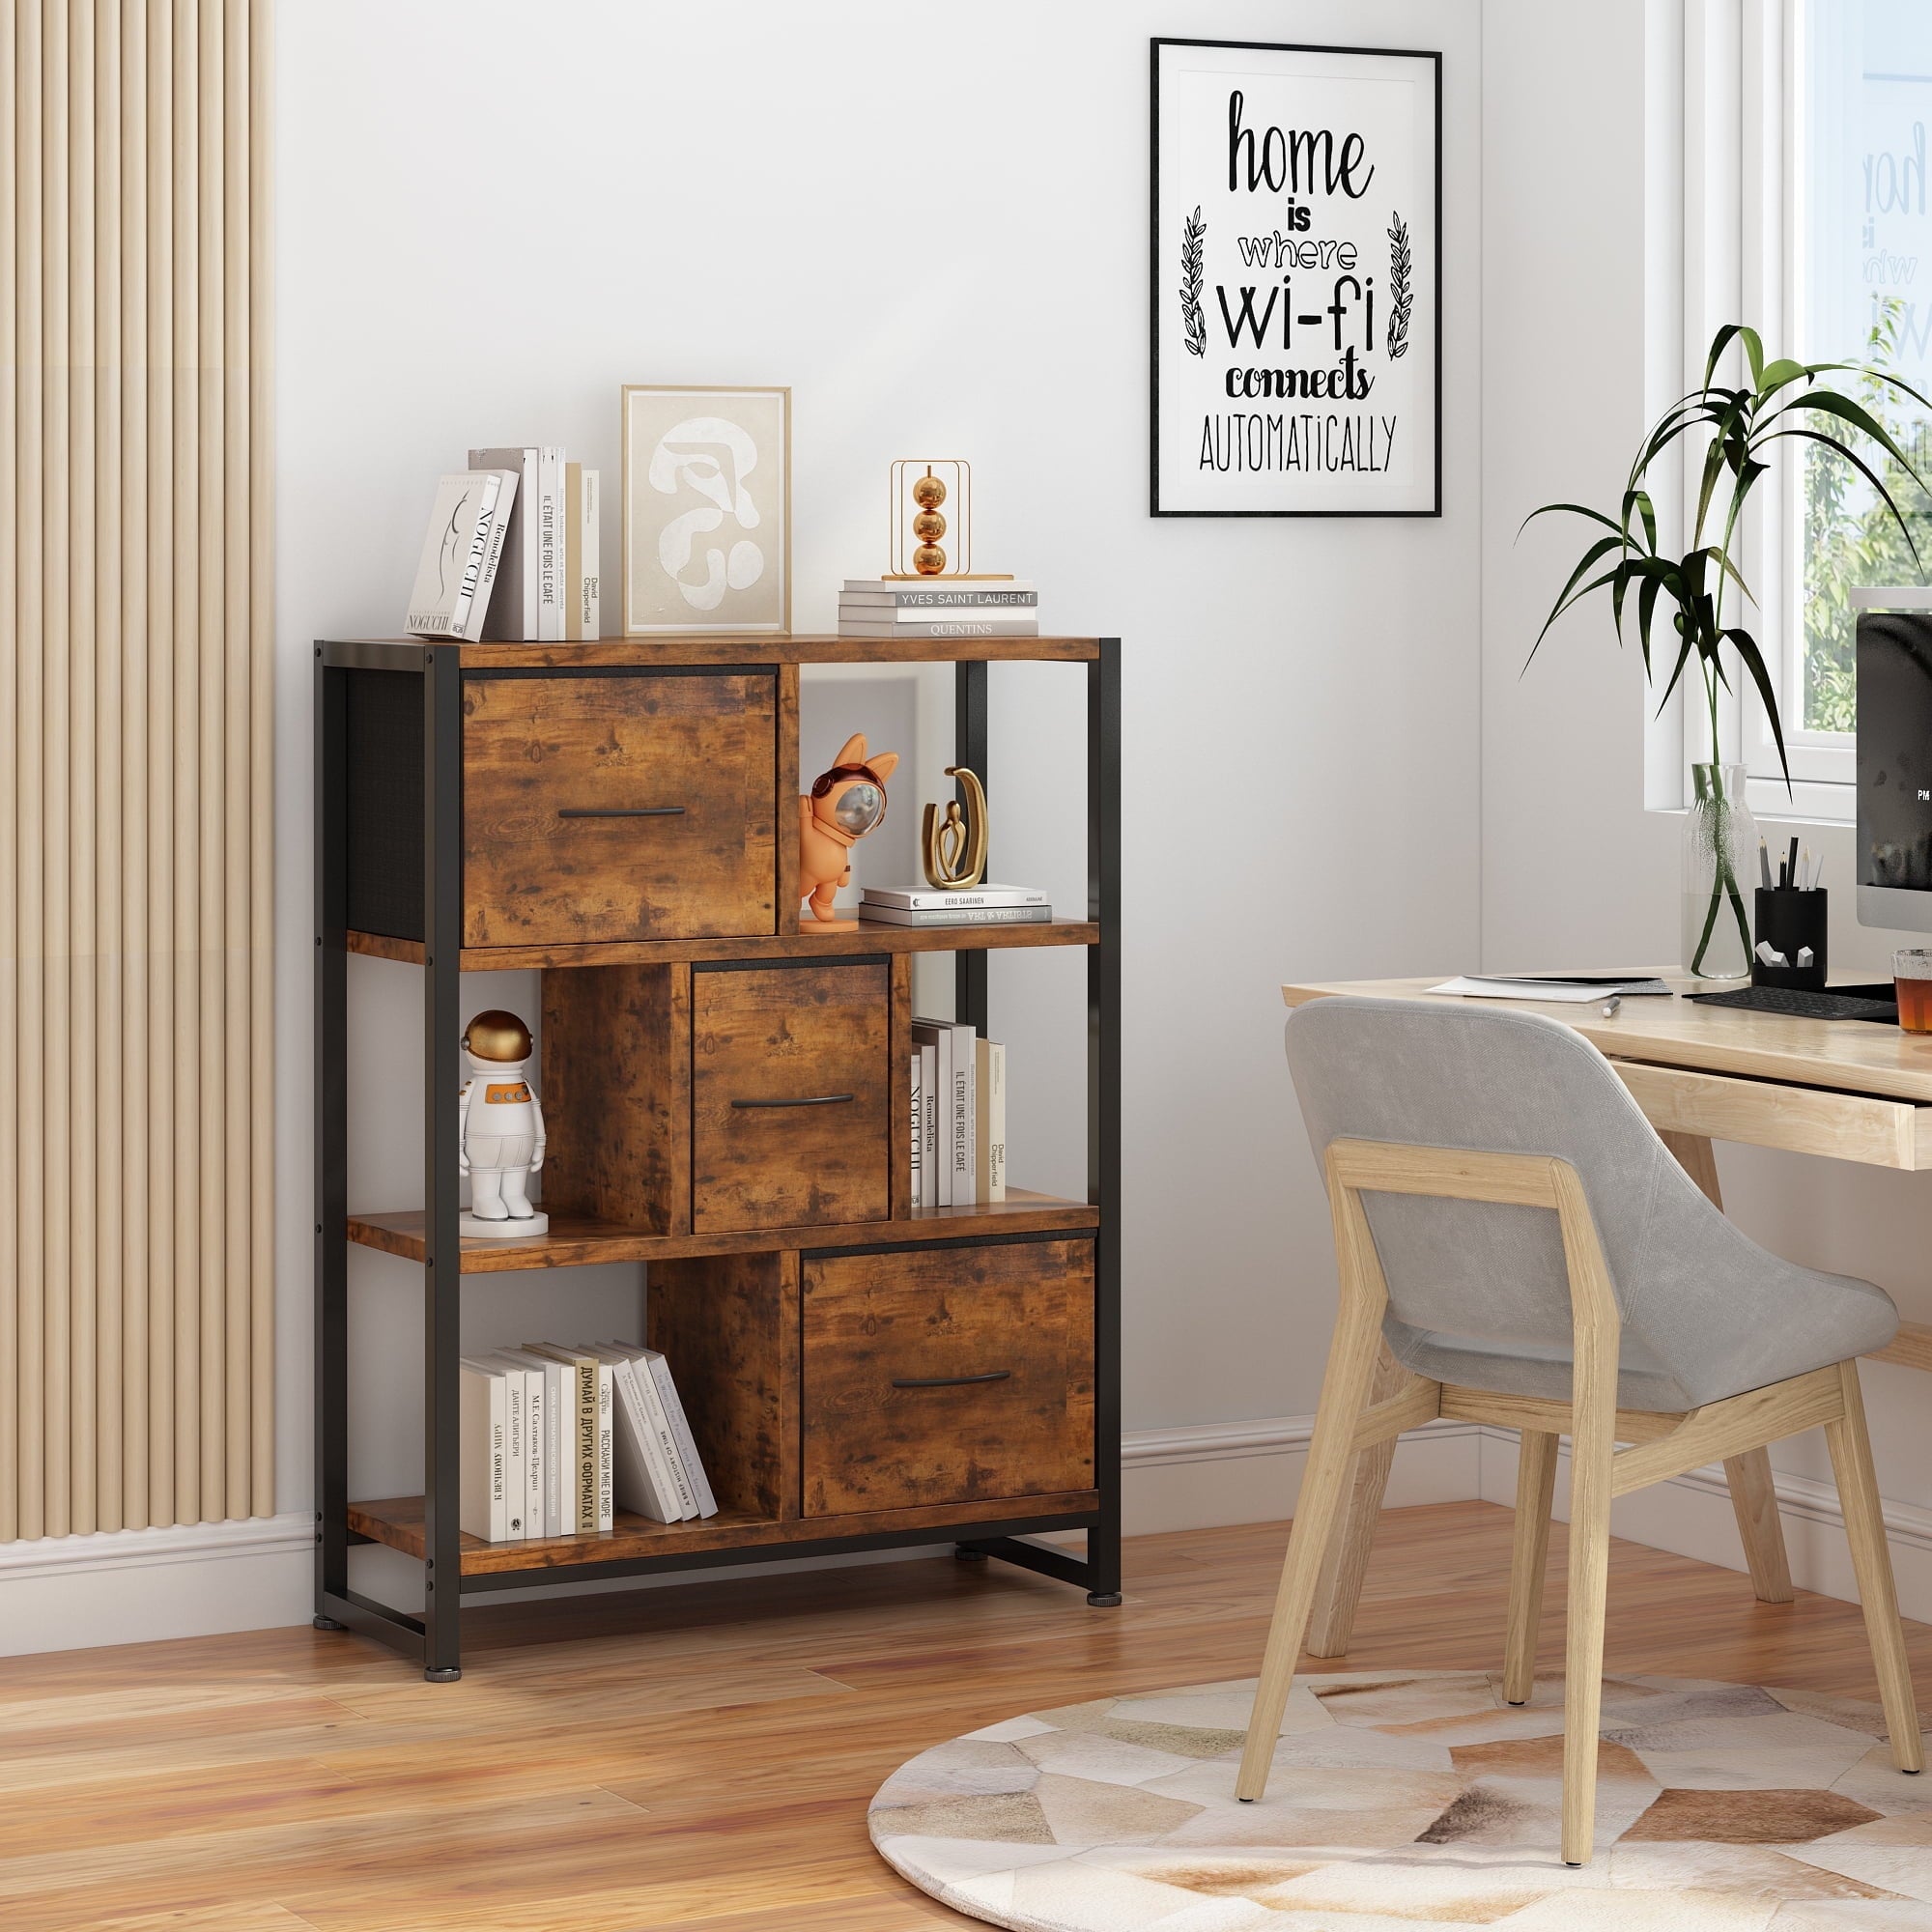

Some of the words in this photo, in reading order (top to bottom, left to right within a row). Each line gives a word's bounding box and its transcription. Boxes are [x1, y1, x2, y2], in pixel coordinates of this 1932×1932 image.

[1229, 90, 1375, 199] home
[1288, 197, 1311, 232] is
[1237, 231, 1358, 270] where
[1225, 346, 1376, 401] connects
[543, 504, 554, 528] ÉTAIT
[543, 530, 553, 548] UNE
[461, 507, 494, 599] NOGUCHI
[484, 524, 505, 583] Remodelista
[543, 550, 553, 568] FOIS
[543, 570, 553, 581] LE
[542, 582, 554, 605] CAFÉ
[901, 594, 933, 605] YVES
[937, 594, 973, 605] SAINT
[978, 593, 1034, 604] LAURENT
[407, 614, 449, 631] NOGUCHI
[930, 624, 992, 636] QUENTINS
[955, 1080, 966, 1102] ÉTAIT
[926, 1095, 935, 1152] Remodelista
[955, 1103, 965, 1121] UNE
[955, 1122, 965, 1140] FOIS
[955, 1141, 965, 1151] LE
[955, 1151, 966, 1173] CAFÉ
[581, 1366, 595, 1404] ДУМАЙ
[511, 1389, 520, 1416] ДАНТЕ
[494, 1423, 502, 1449] МИРУ
[581, 1418, 593, 1459] ДРУГИХ
[659, 1430, 669, 1445] TIME
[601, 1430, 611, 1470] РАССКАЖИ
[665, 1445, 672, 1455] OF
[494, 1452, 502, 1492] ВЕЧНОМУ
[601, 1471, 611, 1489] МНЕ
[668, 1456, 682, 1482] HISTORY
[582, 1462, 593, 1520] ФОРМАТАХ
[678, 1482, 688, 1500] BRIEF
[601, 1497, 611, 1519] МОРЕ
